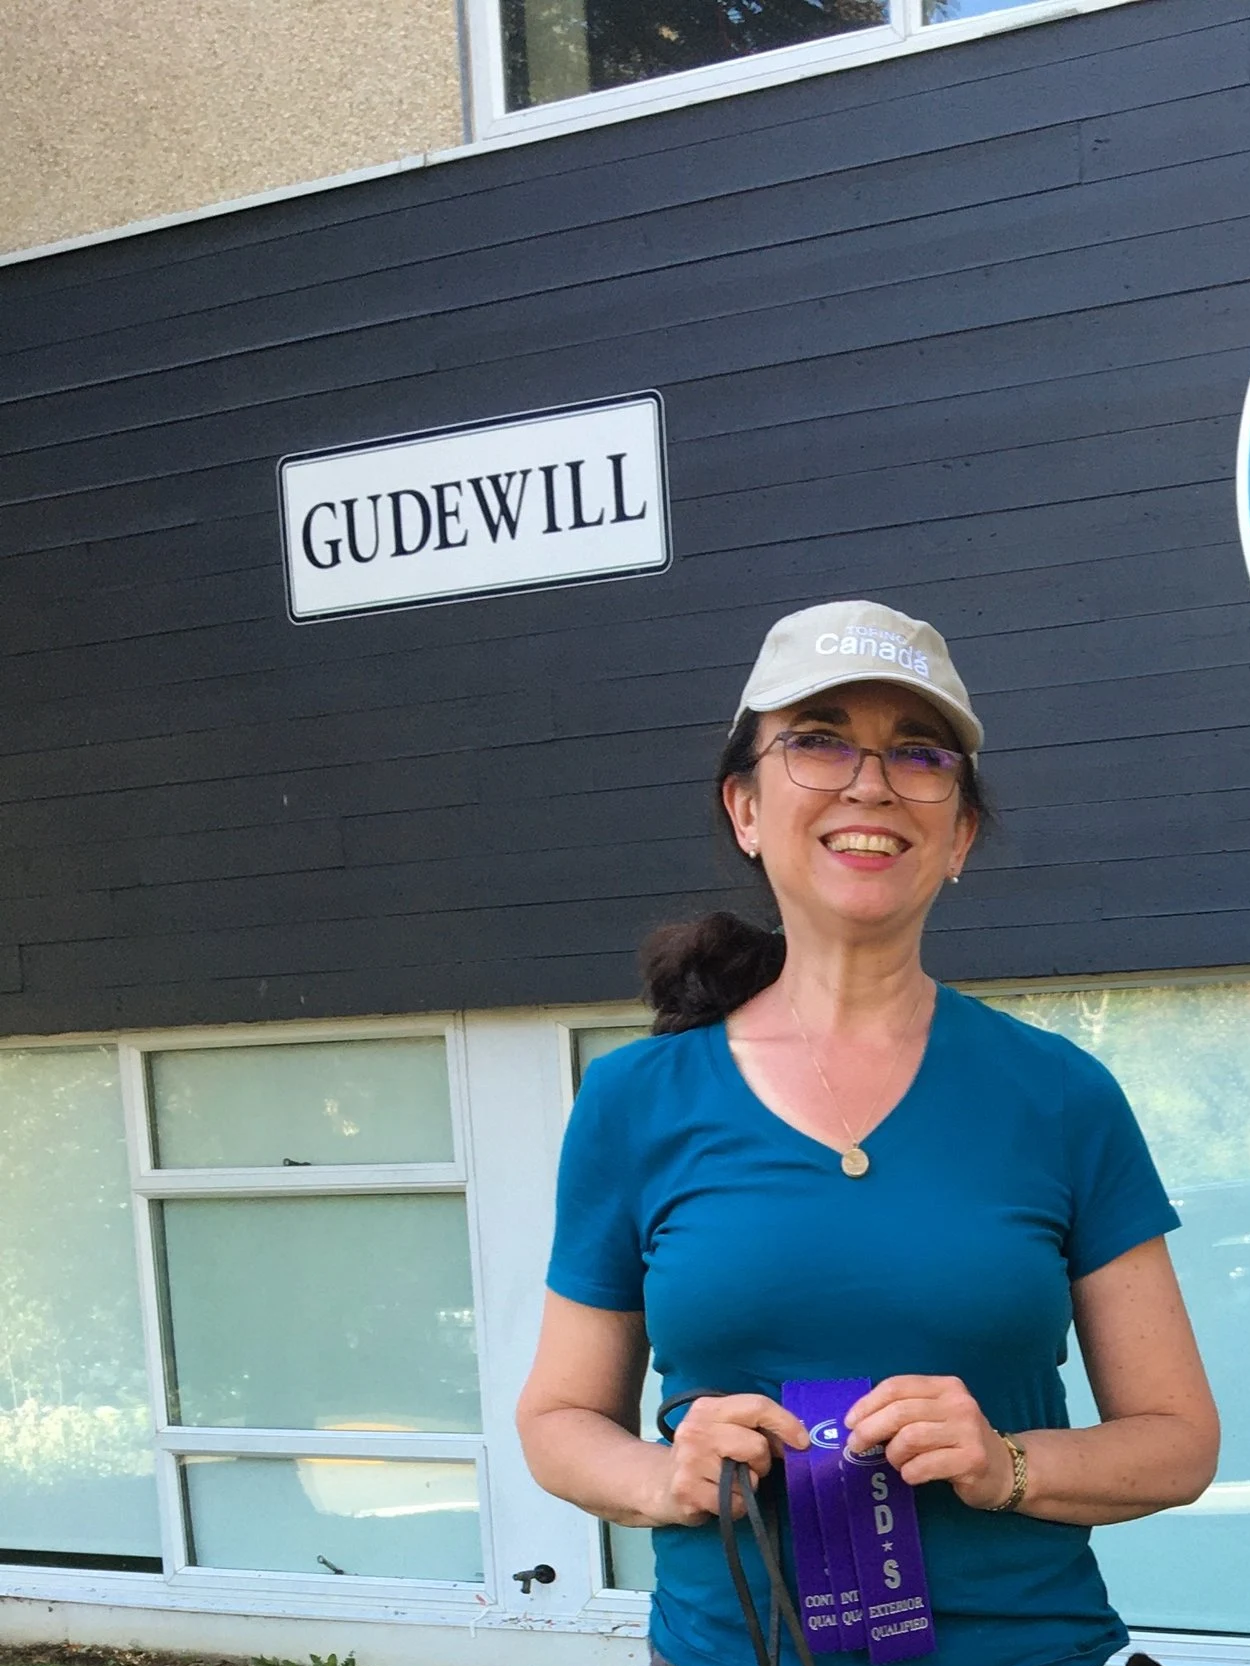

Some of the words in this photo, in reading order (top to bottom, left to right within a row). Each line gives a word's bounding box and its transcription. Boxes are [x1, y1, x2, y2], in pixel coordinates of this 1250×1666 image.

[301, 452, 647, 570] GUDEWILL
[815, 632, 930, 679] Canada
[868, 1596, 925, 1619] EXTERIOR
[871, 1616, 929, 1641] QUALIFIED
